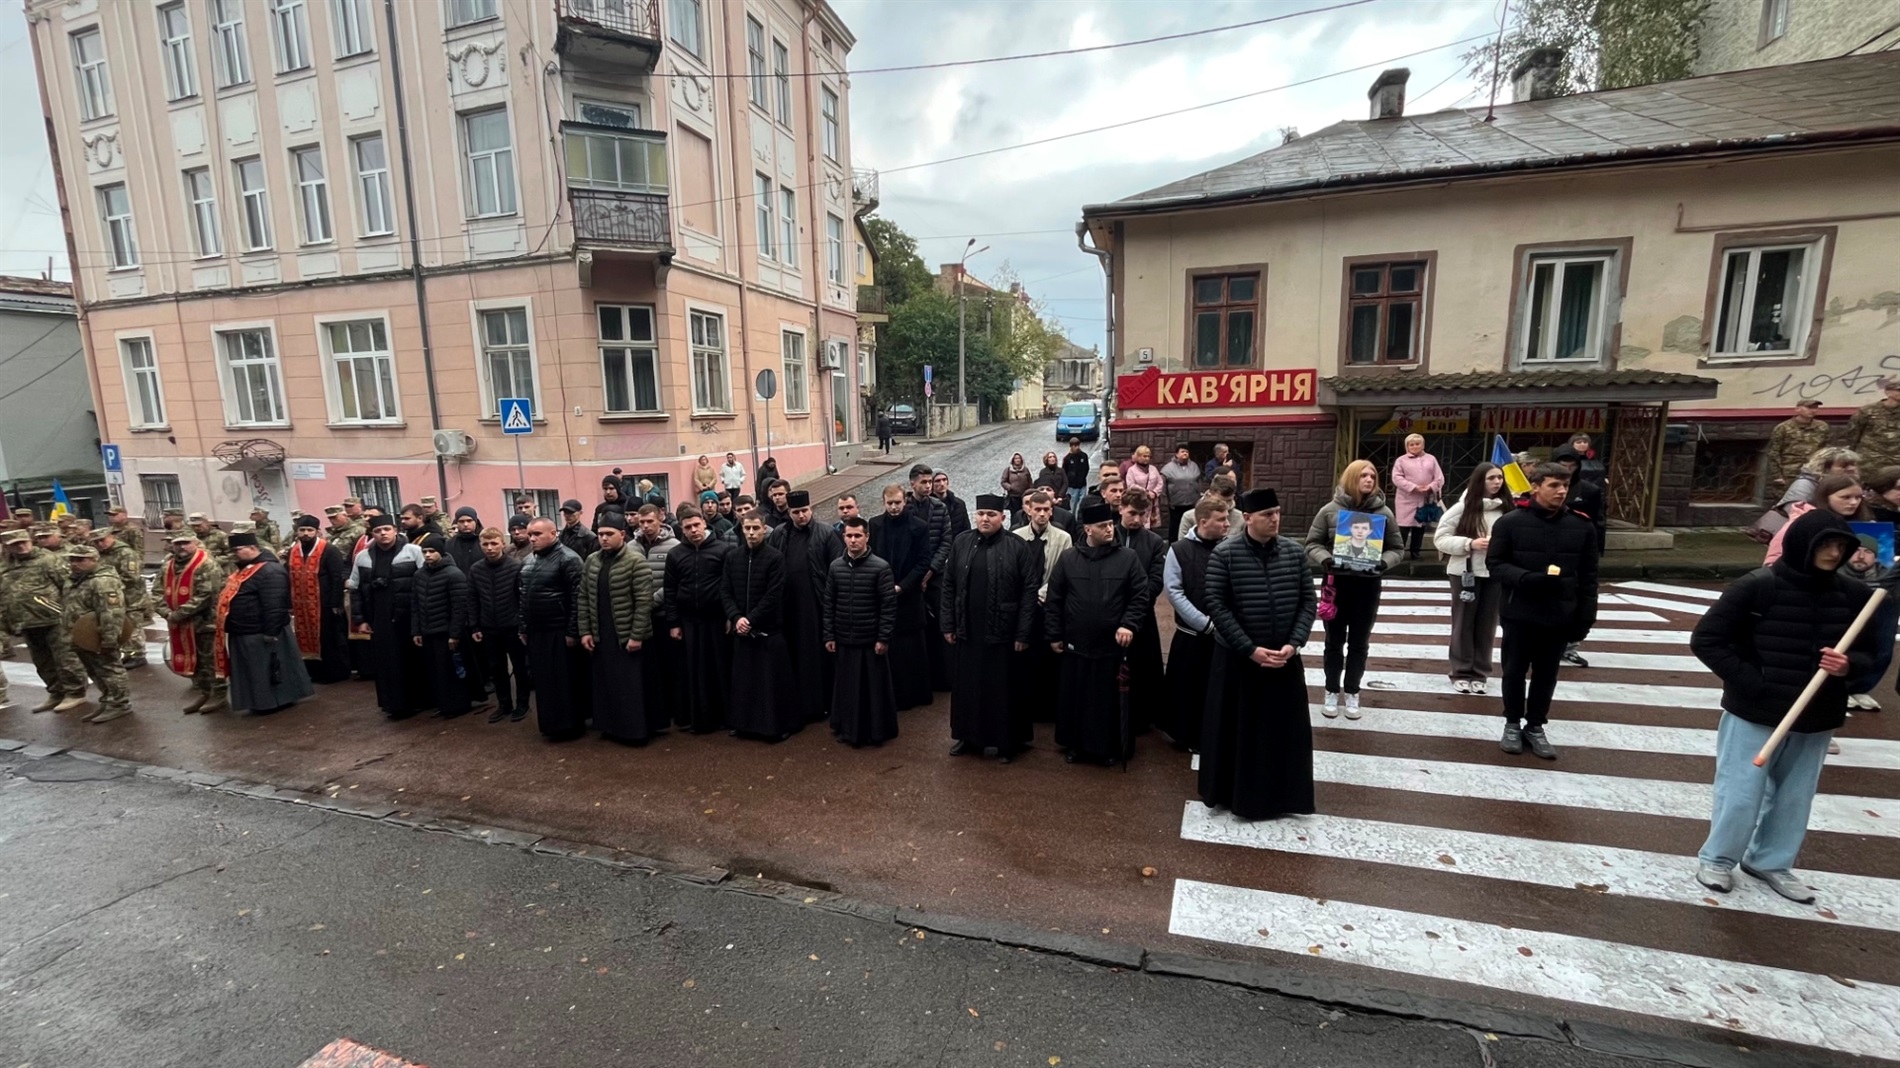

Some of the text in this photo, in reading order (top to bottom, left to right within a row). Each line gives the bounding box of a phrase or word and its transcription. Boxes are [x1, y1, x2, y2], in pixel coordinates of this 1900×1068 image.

[1157, 372, 1313, 405] КАВ'ЯРНЯ
[1426, 420, 1457, 432] Бар
[106, 448, 116, 467] P
